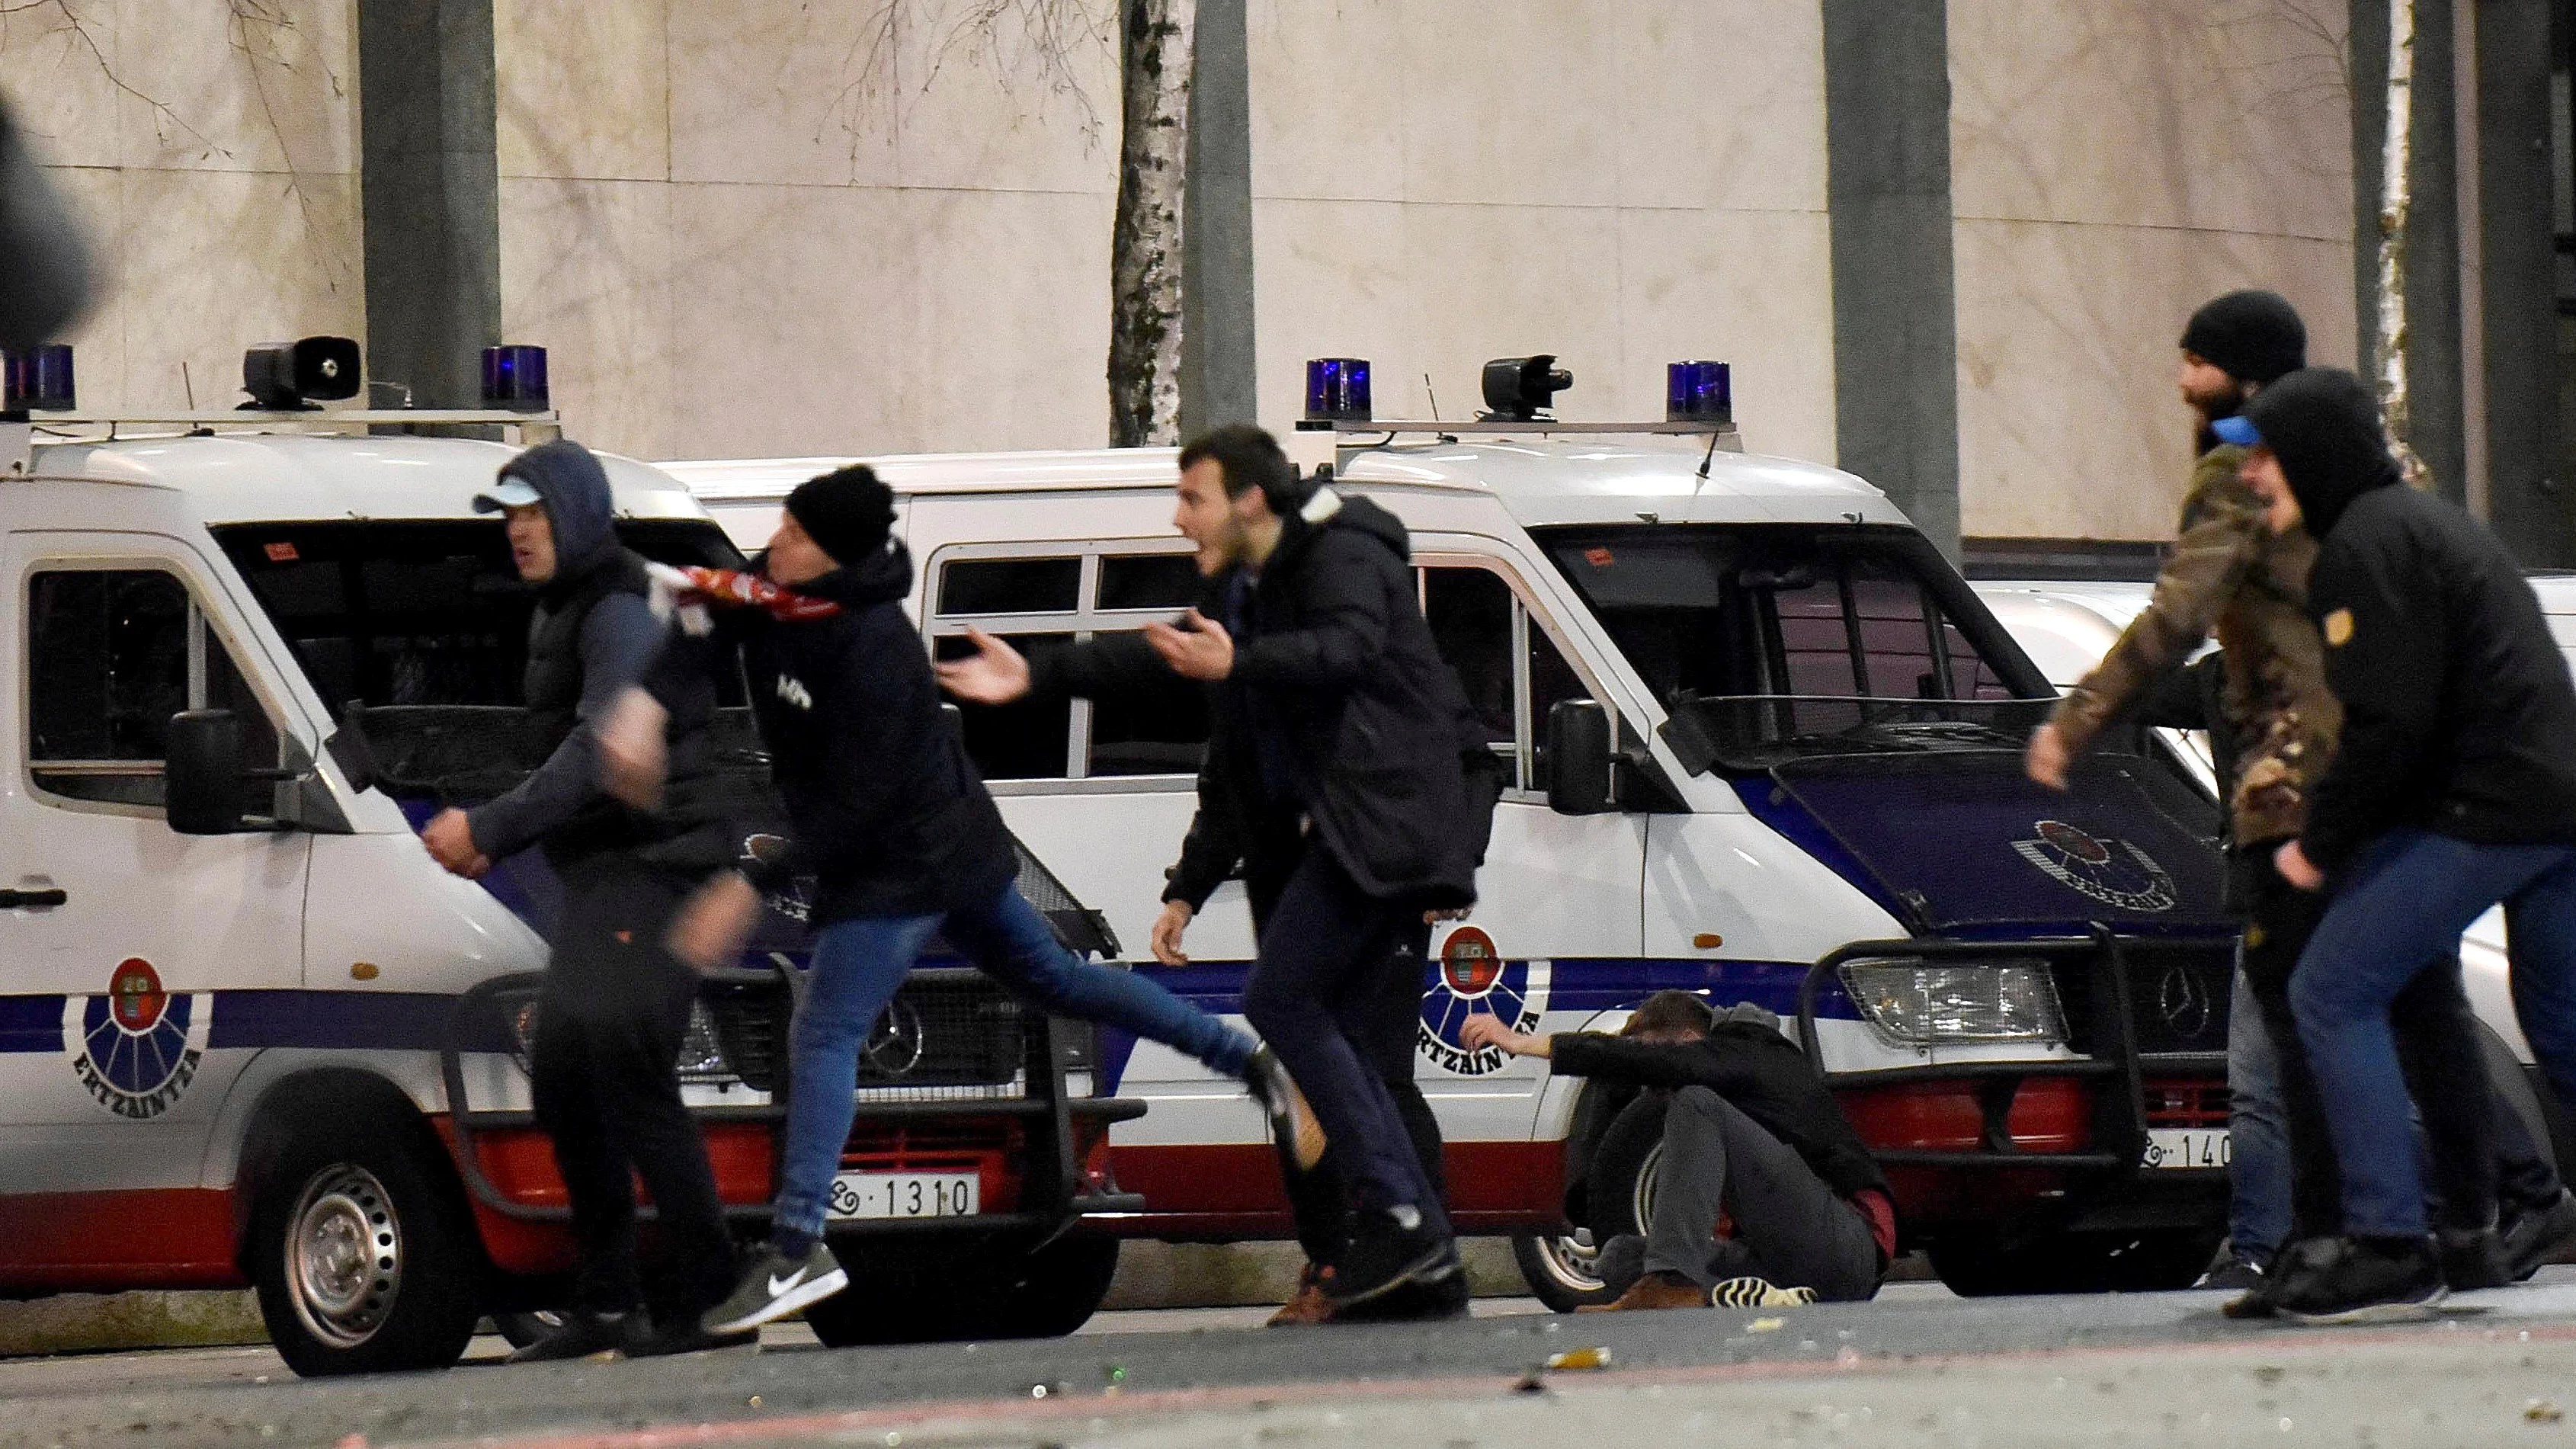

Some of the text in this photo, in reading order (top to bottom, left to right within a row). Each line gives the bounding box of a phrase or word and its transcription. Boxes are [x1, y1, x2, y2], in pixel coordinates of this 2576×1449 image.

[1418, 1011, 1541, 1076] RTZAINA
[73, 1049, 202, 1119] ERTZAINTZA
[887, 1180, 968, 1216] 1310
